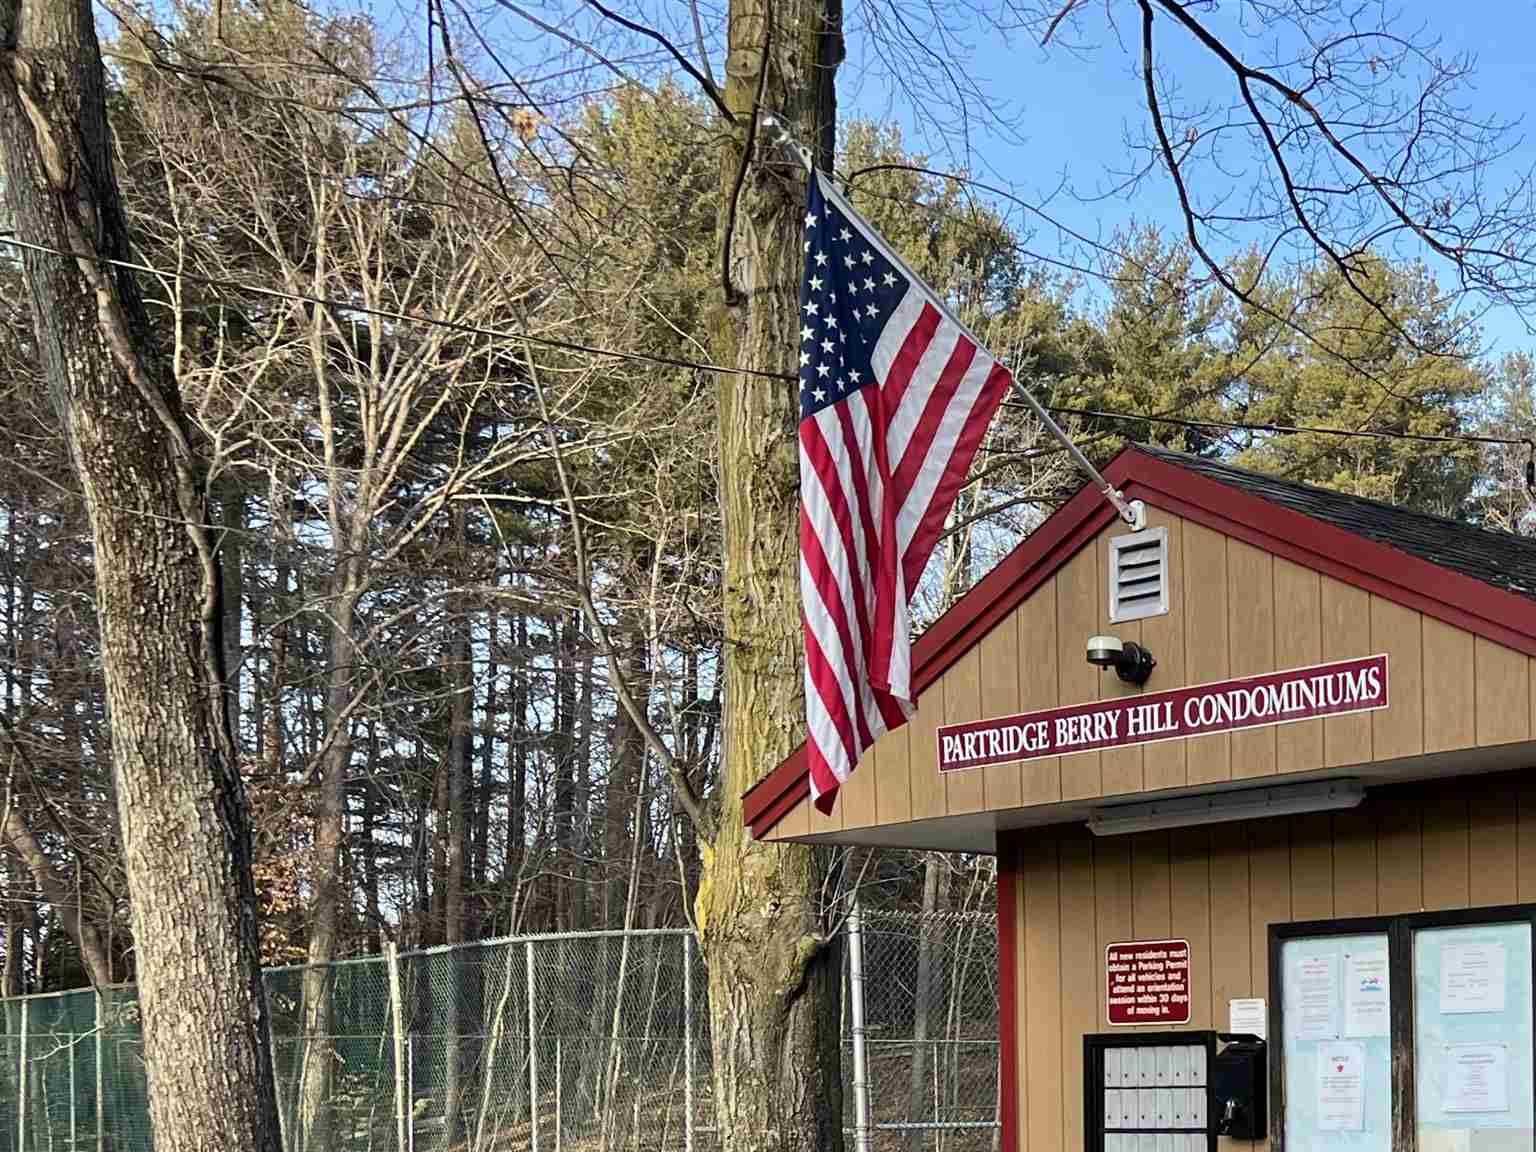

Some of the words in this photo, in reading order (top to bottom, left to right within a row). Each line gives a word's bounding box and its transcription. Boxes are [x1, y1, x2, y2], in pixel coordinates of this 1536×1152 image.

[941, 719, 1050, 764] PARTRIDGE
[1055, 709, 1122, 748] BERRY
[1126, 701, 1179, 737] HILL
[1184, 666, 1381, 727] CONDOMINIUMS
[1109, 952, 1118, 961] All
[1119, 953, 1134, 961] new
[1135, 950, 1168, 960] residents
[1169, 949, 1187, 958] must
[1108, 963, 1130, 972] obtain
[1138, 961, 1164, 972] Parking
[1165, 960, 1188, 970] Permit
[1115, 973, 1126, 983] for
[1127, 973, 1136, 983] all
[1137, 972, 1166, 982] vehicles
[1167, 971, 1182, 981] and
[1112, 984, 1135, 994] attend
[1147, 983, 1185, 992] orientation
[1109, 995, 1136, 1005] session
[1171, 994, 1188, 1004] days
[1126, 1006, 1135, 1015] of
[1135, 1006, 1160, 1016] moving
